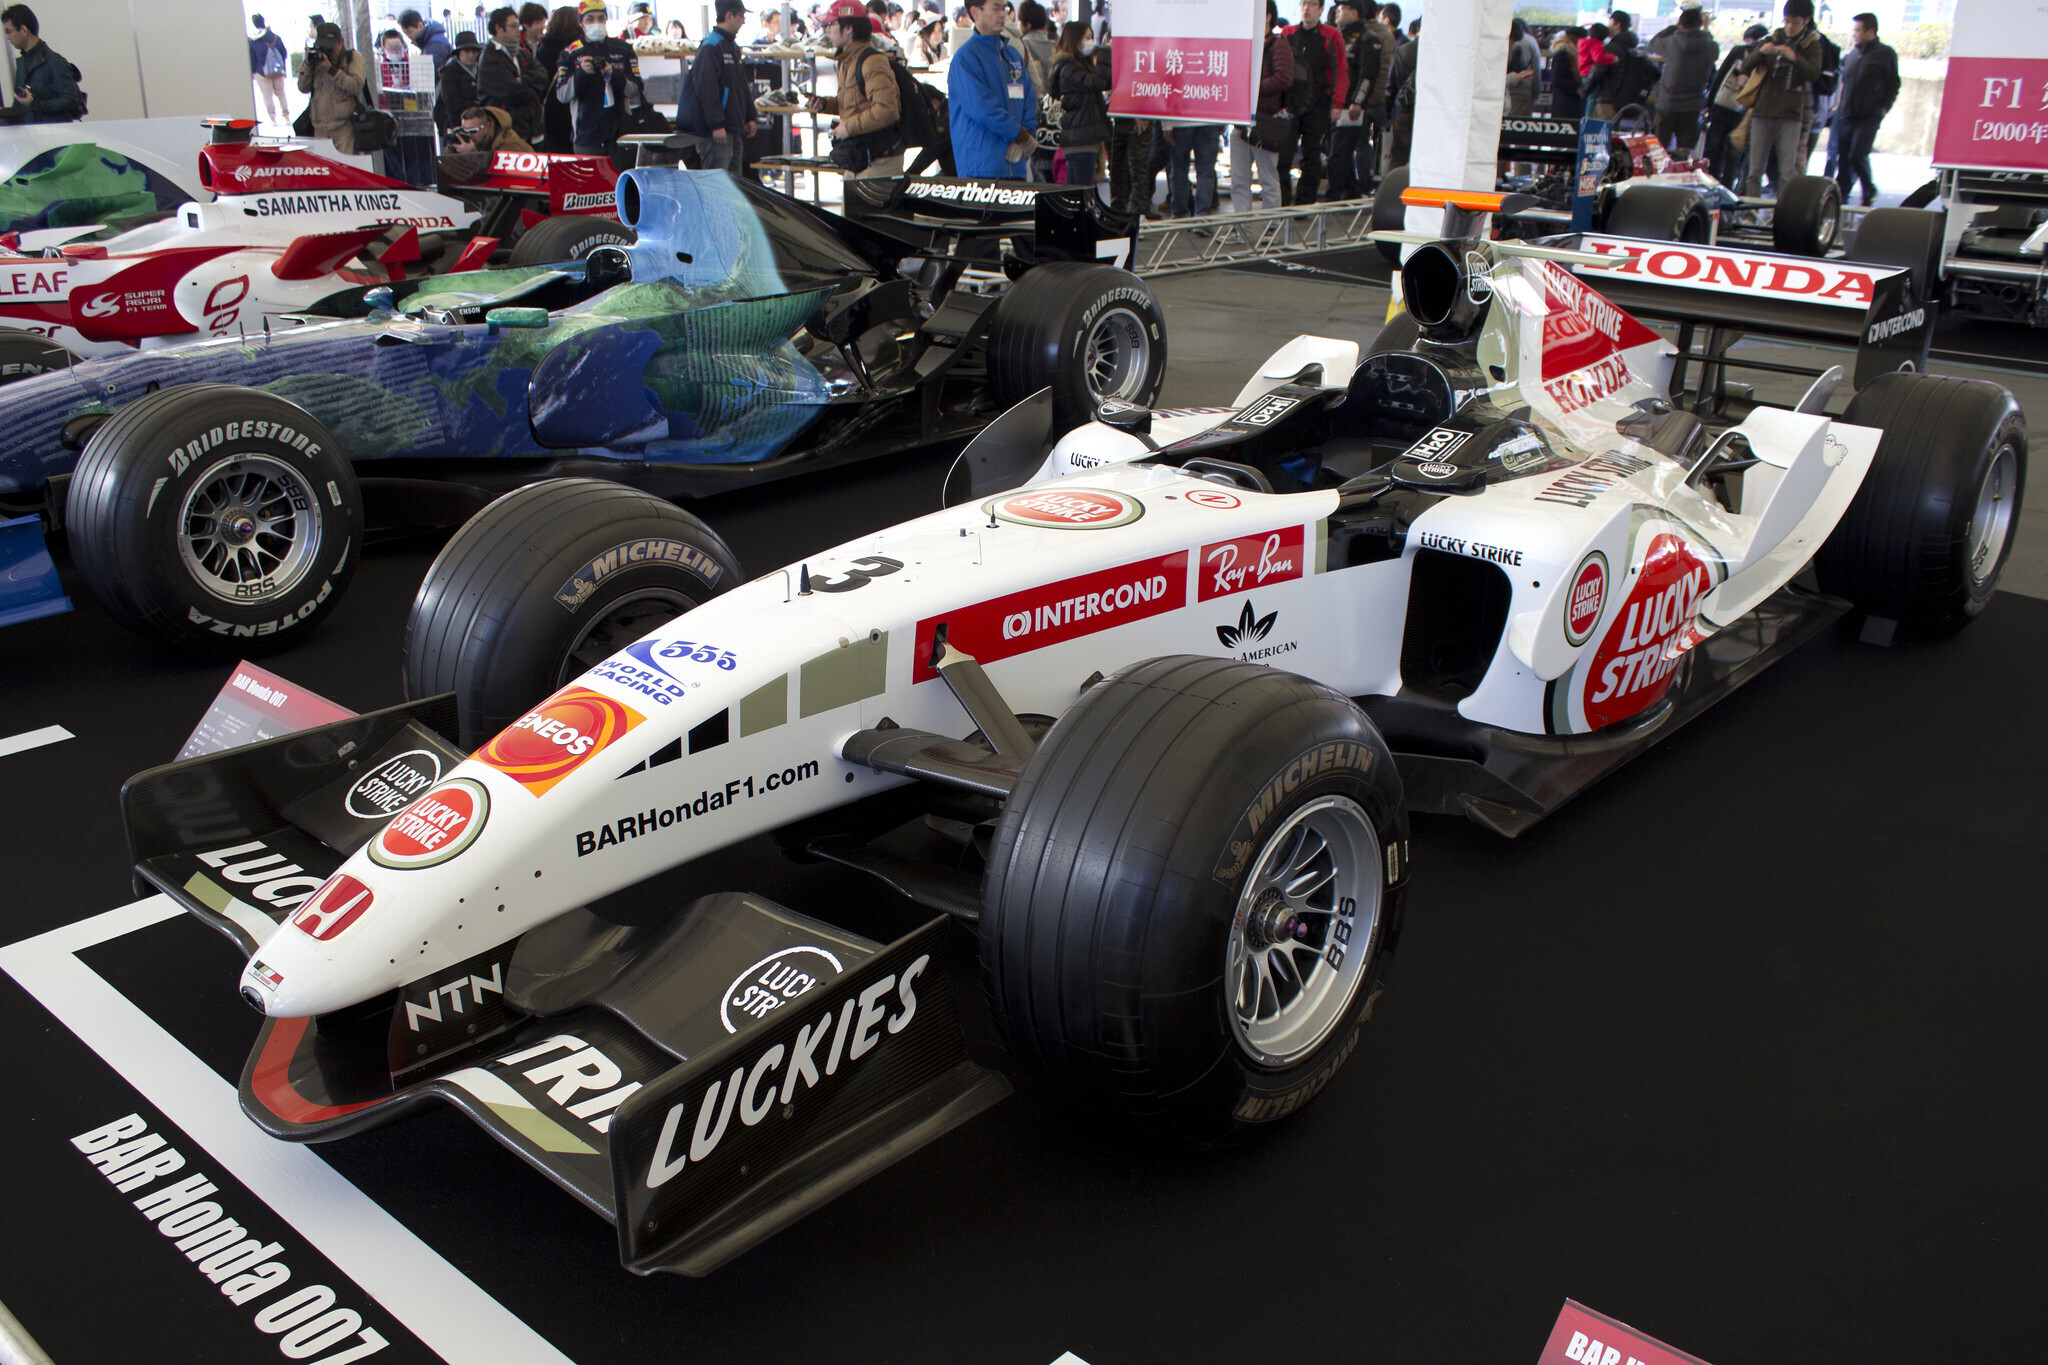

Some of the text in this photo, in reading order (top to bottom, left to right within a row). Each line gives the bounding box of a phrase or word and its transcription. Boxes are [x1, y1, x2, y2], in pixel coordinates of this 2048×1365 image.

[1133, 48, 1229, 78] F1 第三期
[1978, 77, 2024, 109] F1
[253, 166, 330, 178] AUTOBACS
[257, 194, 402, 216] SAMANTHA KINGZ
[1096, 236, 1131, 269] 7
[1468, 261, 1488, 276] LUCKY
[1584, 242, 1877, 303] HONDA
[124, 290, 165, 299] SUPER
[125, 297, 162, 306] AGURI
[141, 304, 168, 312] TEAM
[1082, 287, 1151, 330] BRIDGESTONE
[1544, 264, 1623, 342] LUCKY STRIKE
[1878, 307, 1926, 343] INTERCOND
[1544, 354, 1633, 414] HONDA
[168, 420, 322, 478] BRIDGESTONE
[276, 474, 309, 511] BBS
[1534, 449, 1654, 509] LUCKY STRIKE
[1010, 499, 1098, 522] STRIKE
[1037, 494, 1117, 515] LUCKY
[592, 540, 720, 581] MICHELIN
[1420, 532, 1524, 567] LUCKY STRIKE
[235, 577, 277, 597] BBS
[809, 555, 905, 593] 3
[1575, 576, 1602, 598] LUCKY
[188, 580, 333, 637] POTENZA
[1034, 575, 1168, 632] INTERCOND
[1571, 594, 1600, 622] STRIKE
[1618, 566, 1702, 653] LUCKY
[659, 640, 738, 671] 555
[1240, 641, 1298, 662] AMERICAN
[232, 673, 288, 708] BAR Honda 007
[587, 667, 673, 706] RACING
[601, 660, 685, 698] WORLD
[513, 712, 594, 755] ENEOS
[356, 777, 408, 813] STRIKE
[380, 760, 433, 795] LUCKY
[1247, 743, 1374, 836] MICHELIN
[411, 798, 467, 831] LUCKY
[575, 760, 820, 858] BARHondaF1.com
[391, 813, 448, 851] STRIKE
[1325, 896, 1357, 972] BBS
[405, 962, 504, 1032] NTN
[646, 954, 930, 1189] LUCKIES
[69, 1112, 391, 1365] BAR Honda 007
[1564, 1330, 1622, 1365] BAR
